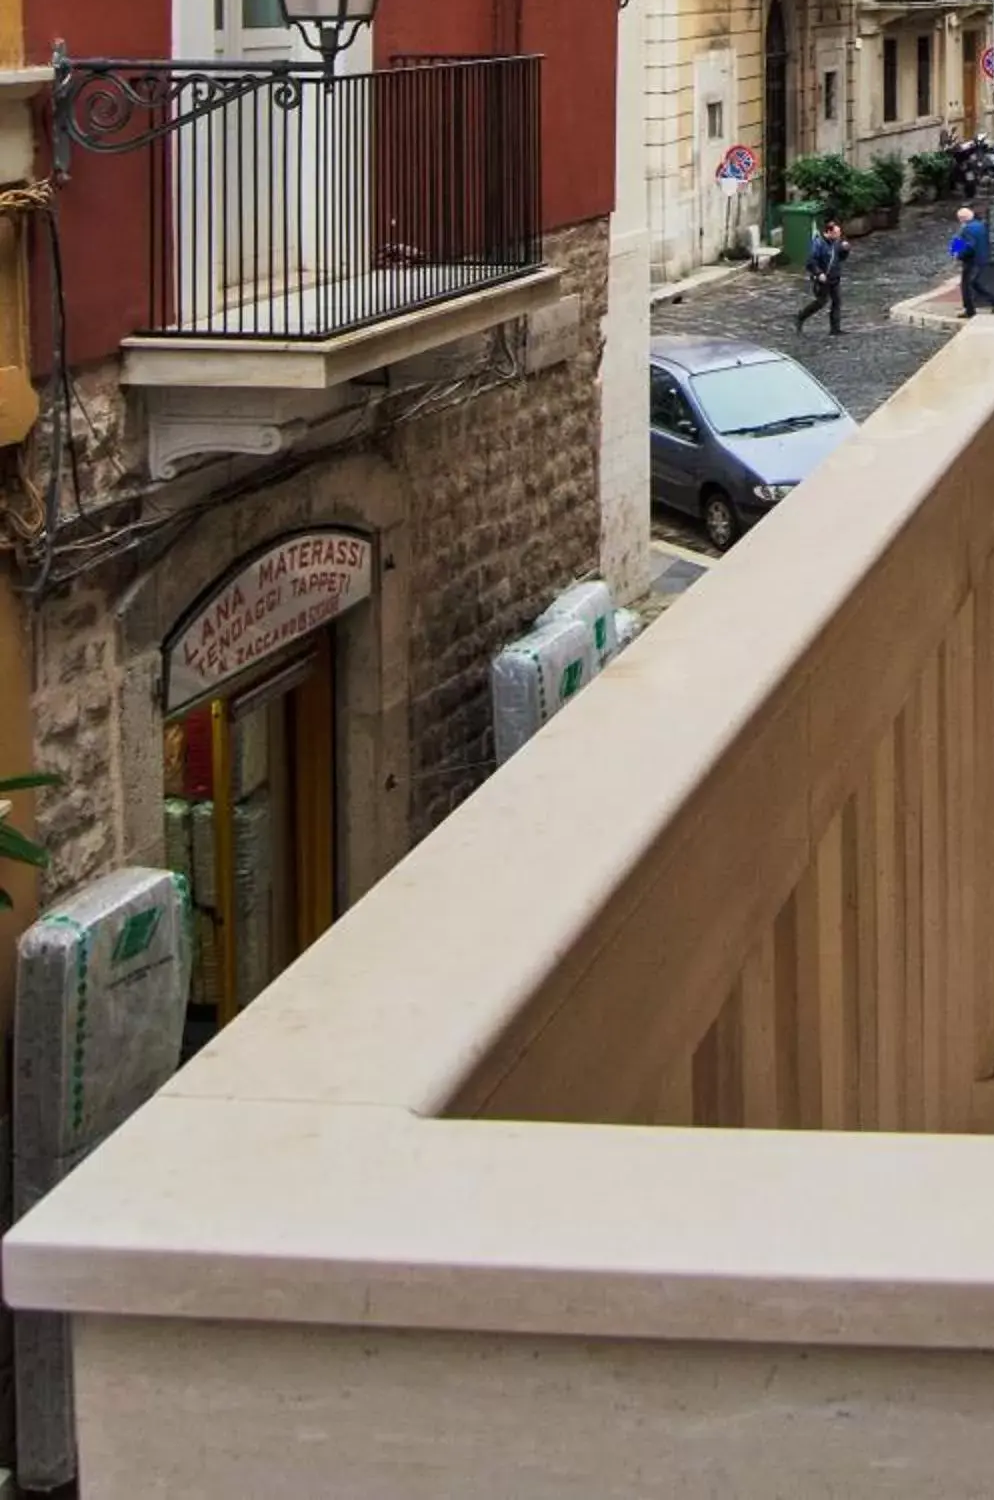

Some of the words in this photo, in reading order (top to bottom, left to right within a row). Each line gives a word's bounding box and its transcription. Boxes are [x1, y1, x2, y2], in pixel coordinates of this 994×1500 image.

[184, 586, 246, 666] LANA
[258, 539, 366, 590] MATERASSI
[198, 587, 281, 677] TENDAGGI
[291, 571, 351, 597] TAPPETI
